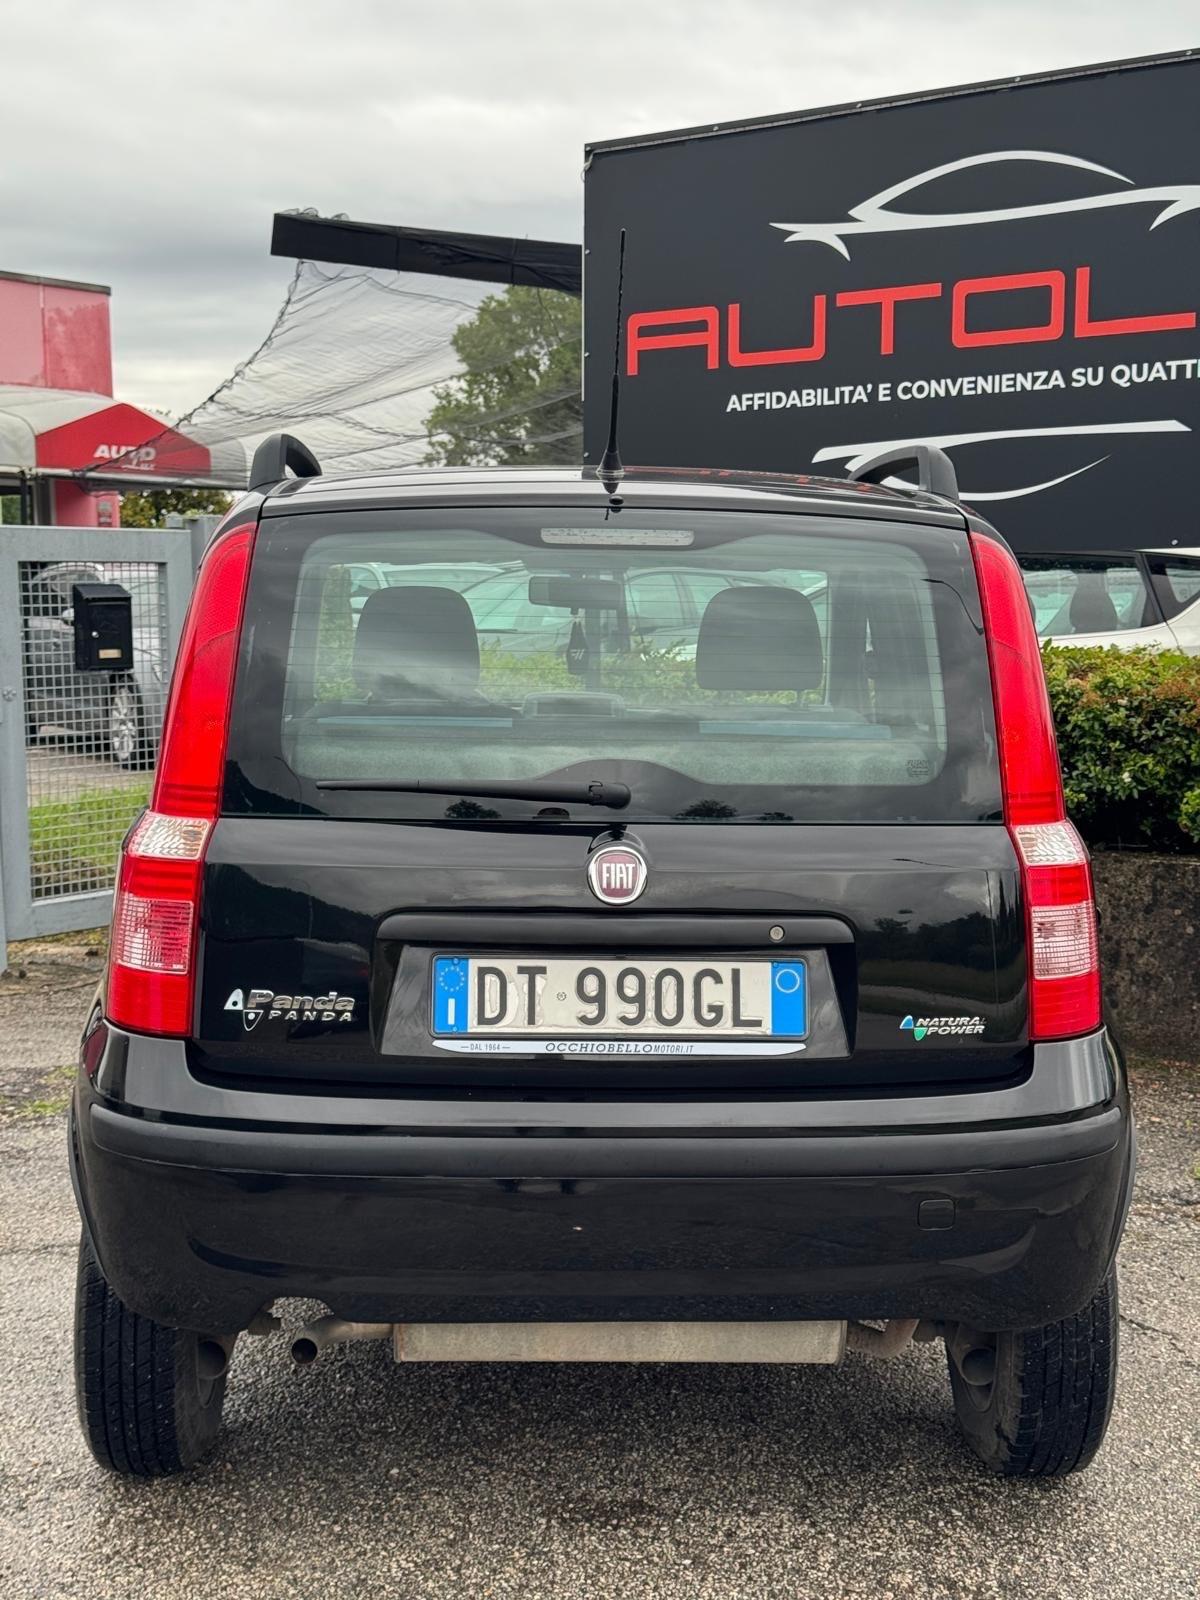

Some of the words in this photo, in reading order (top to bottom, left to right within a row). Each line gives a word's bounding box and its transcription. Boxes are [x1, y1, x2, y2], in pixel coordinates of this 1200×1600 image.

[878, 383, 891, 402] E
[897, 369, 1067, 400] CONVENIENZA
[1071, 366, 1104, 388] SU
[1110, 358, 1200, 388] QUATT
[93, 444, 157, 461] AUTO
[602, 862, 636, 889] FIAT
[247, 989, 355, 1011] Panda
[477, 965, 547, 1026] DT
[576, 966, 763, 1028] 990GL
[268, 1010, 352, 1022] PANDA
[926, 1025, 985, 1036] POWER
[470, 1043, 482, 1051] DAL
